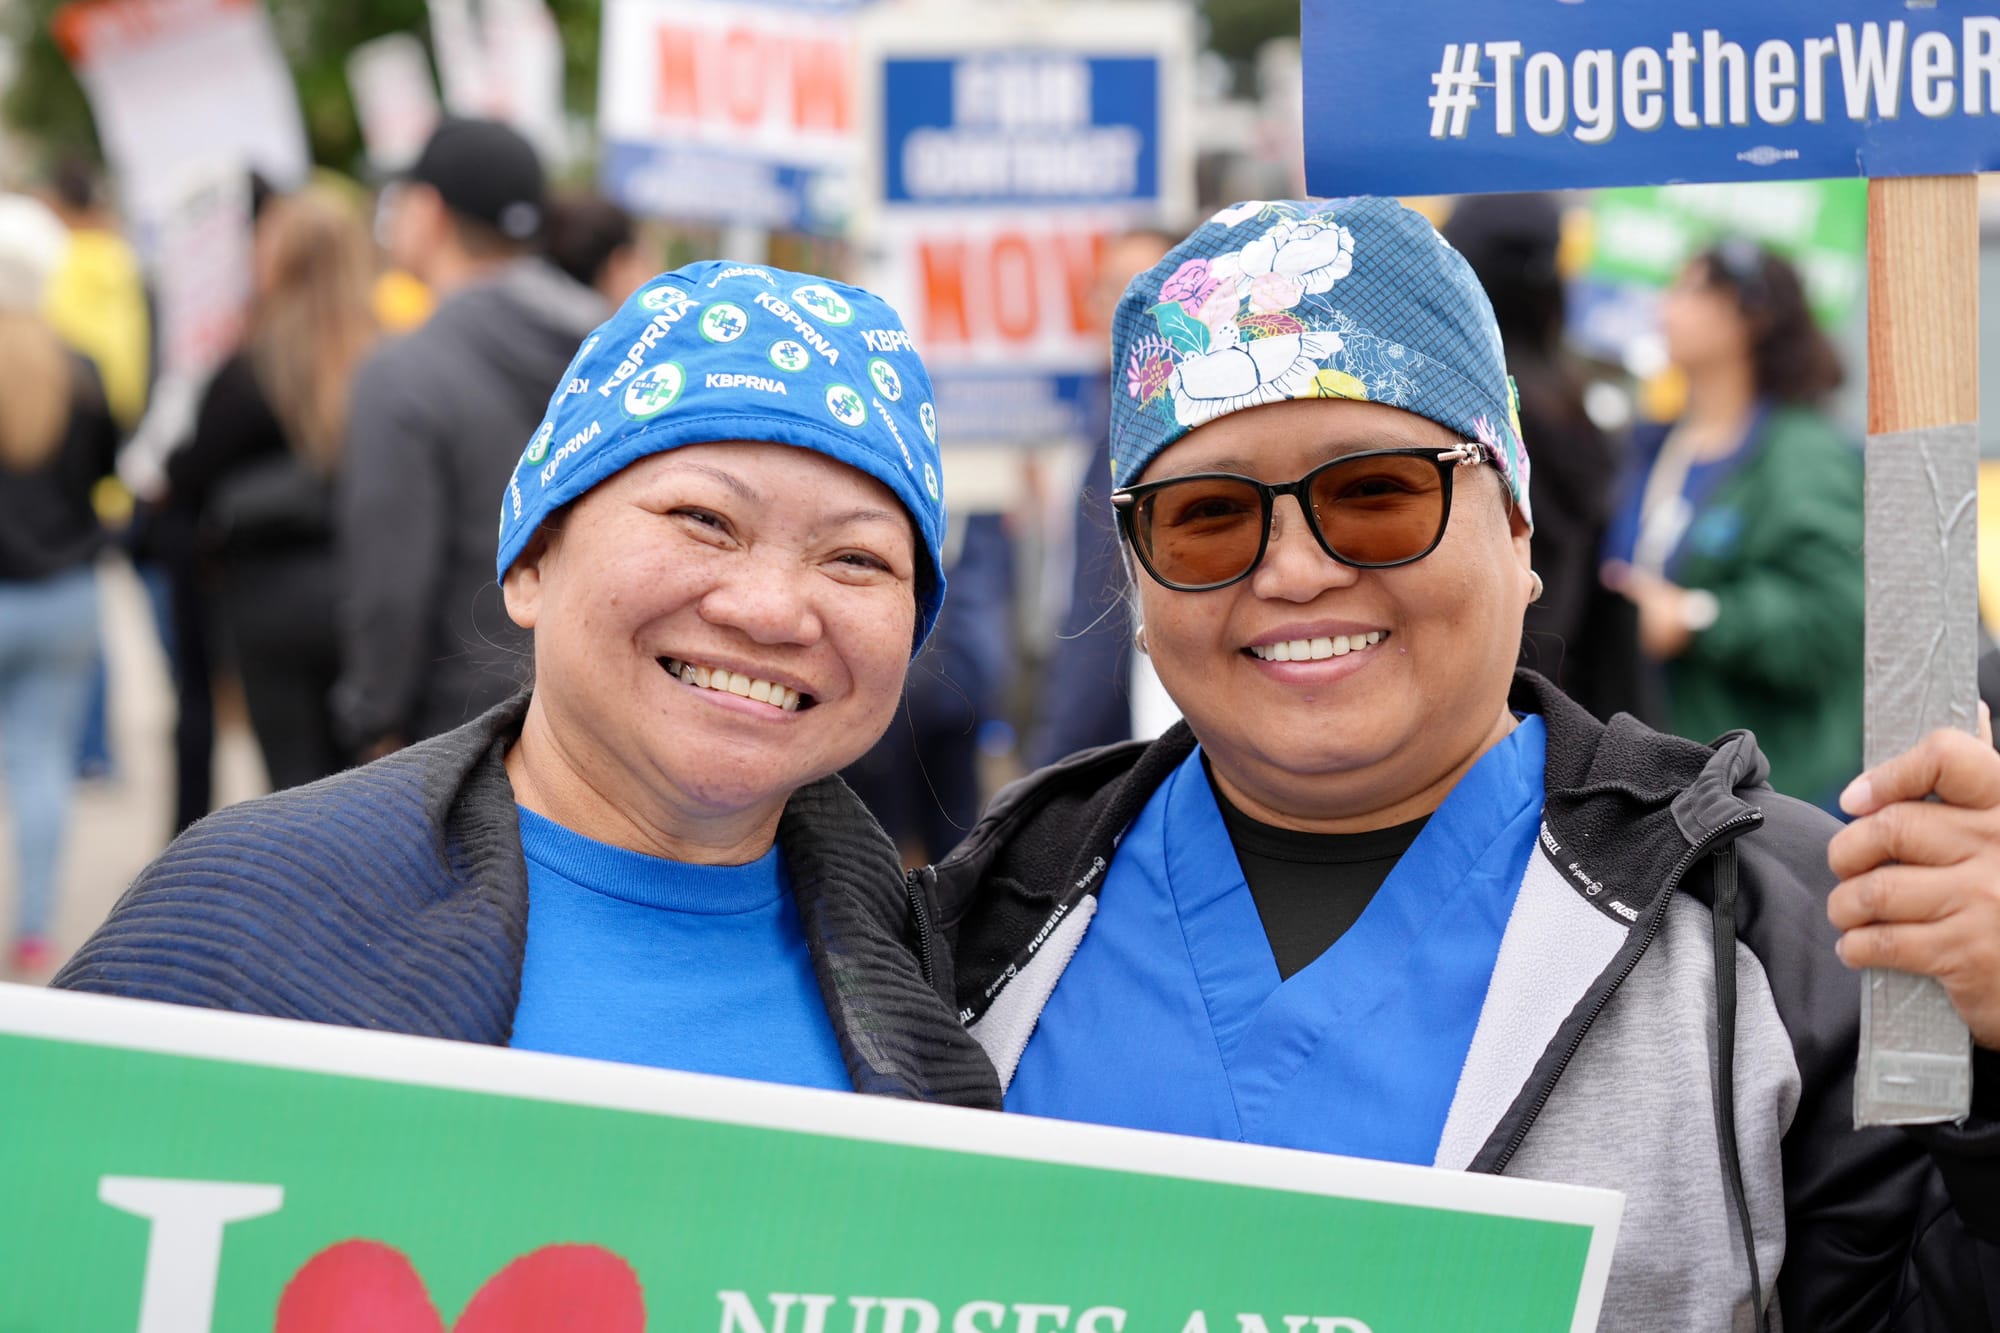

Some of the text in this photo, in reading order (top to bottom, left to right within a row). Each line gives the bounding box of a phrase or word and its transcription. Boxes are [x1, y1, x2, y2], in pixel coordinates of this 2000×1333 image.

[598, 299, 700, 397] KBPRNA
[753, 291, 840, 367] KBPRNA
[705, 373, 787, 395] KBPRNA
